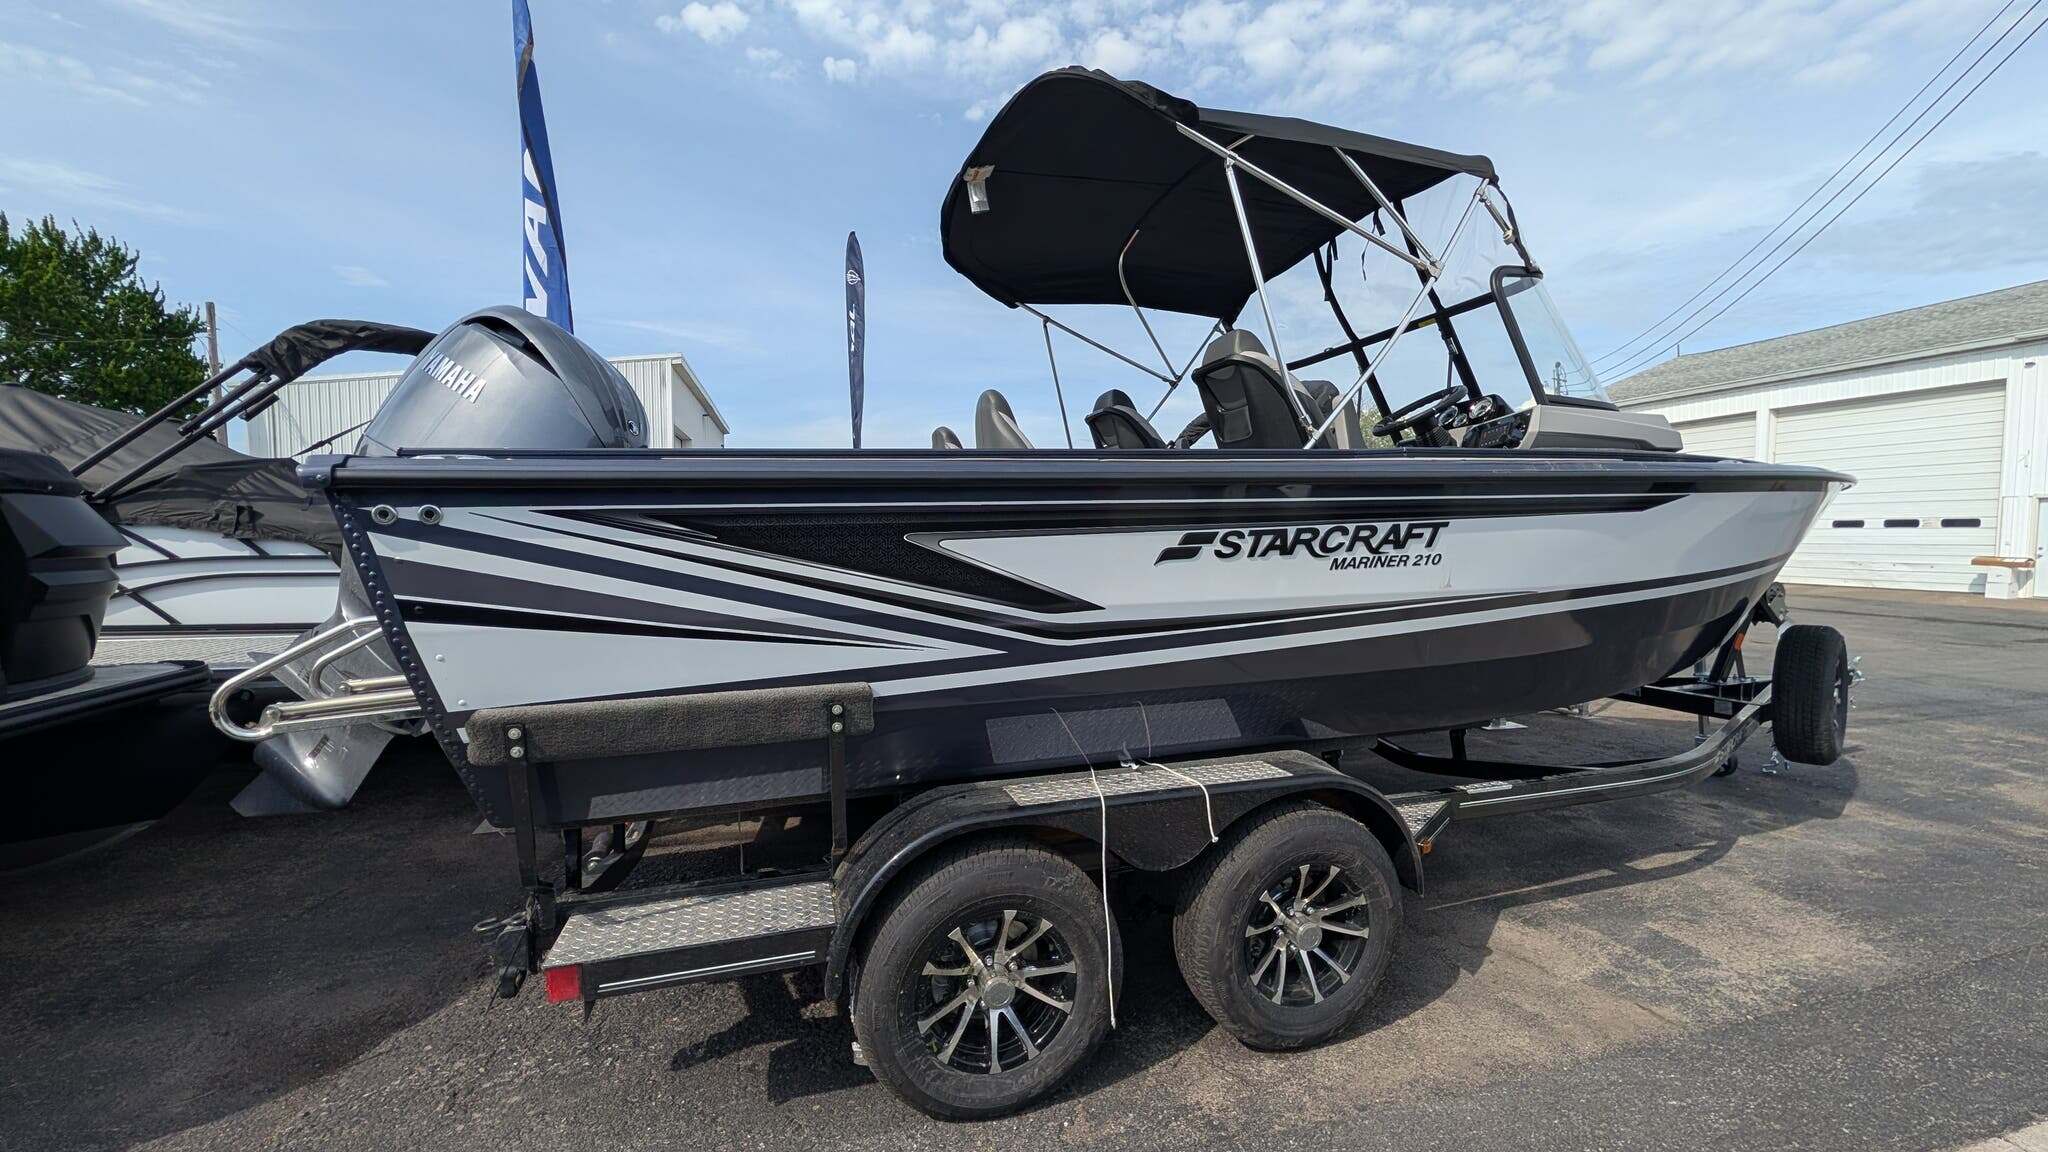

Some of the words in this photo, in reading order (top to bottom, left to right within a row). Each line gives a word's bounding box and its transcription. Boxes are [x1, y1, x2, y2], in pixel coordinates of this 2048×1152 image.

[422, 349, 487, 404] YAMAHA
[1214, 522, 1449, 558] STARCRAFT
[1329, 556, 1408, 571] MARINER
[1412, 553, 1442, 567] 210
